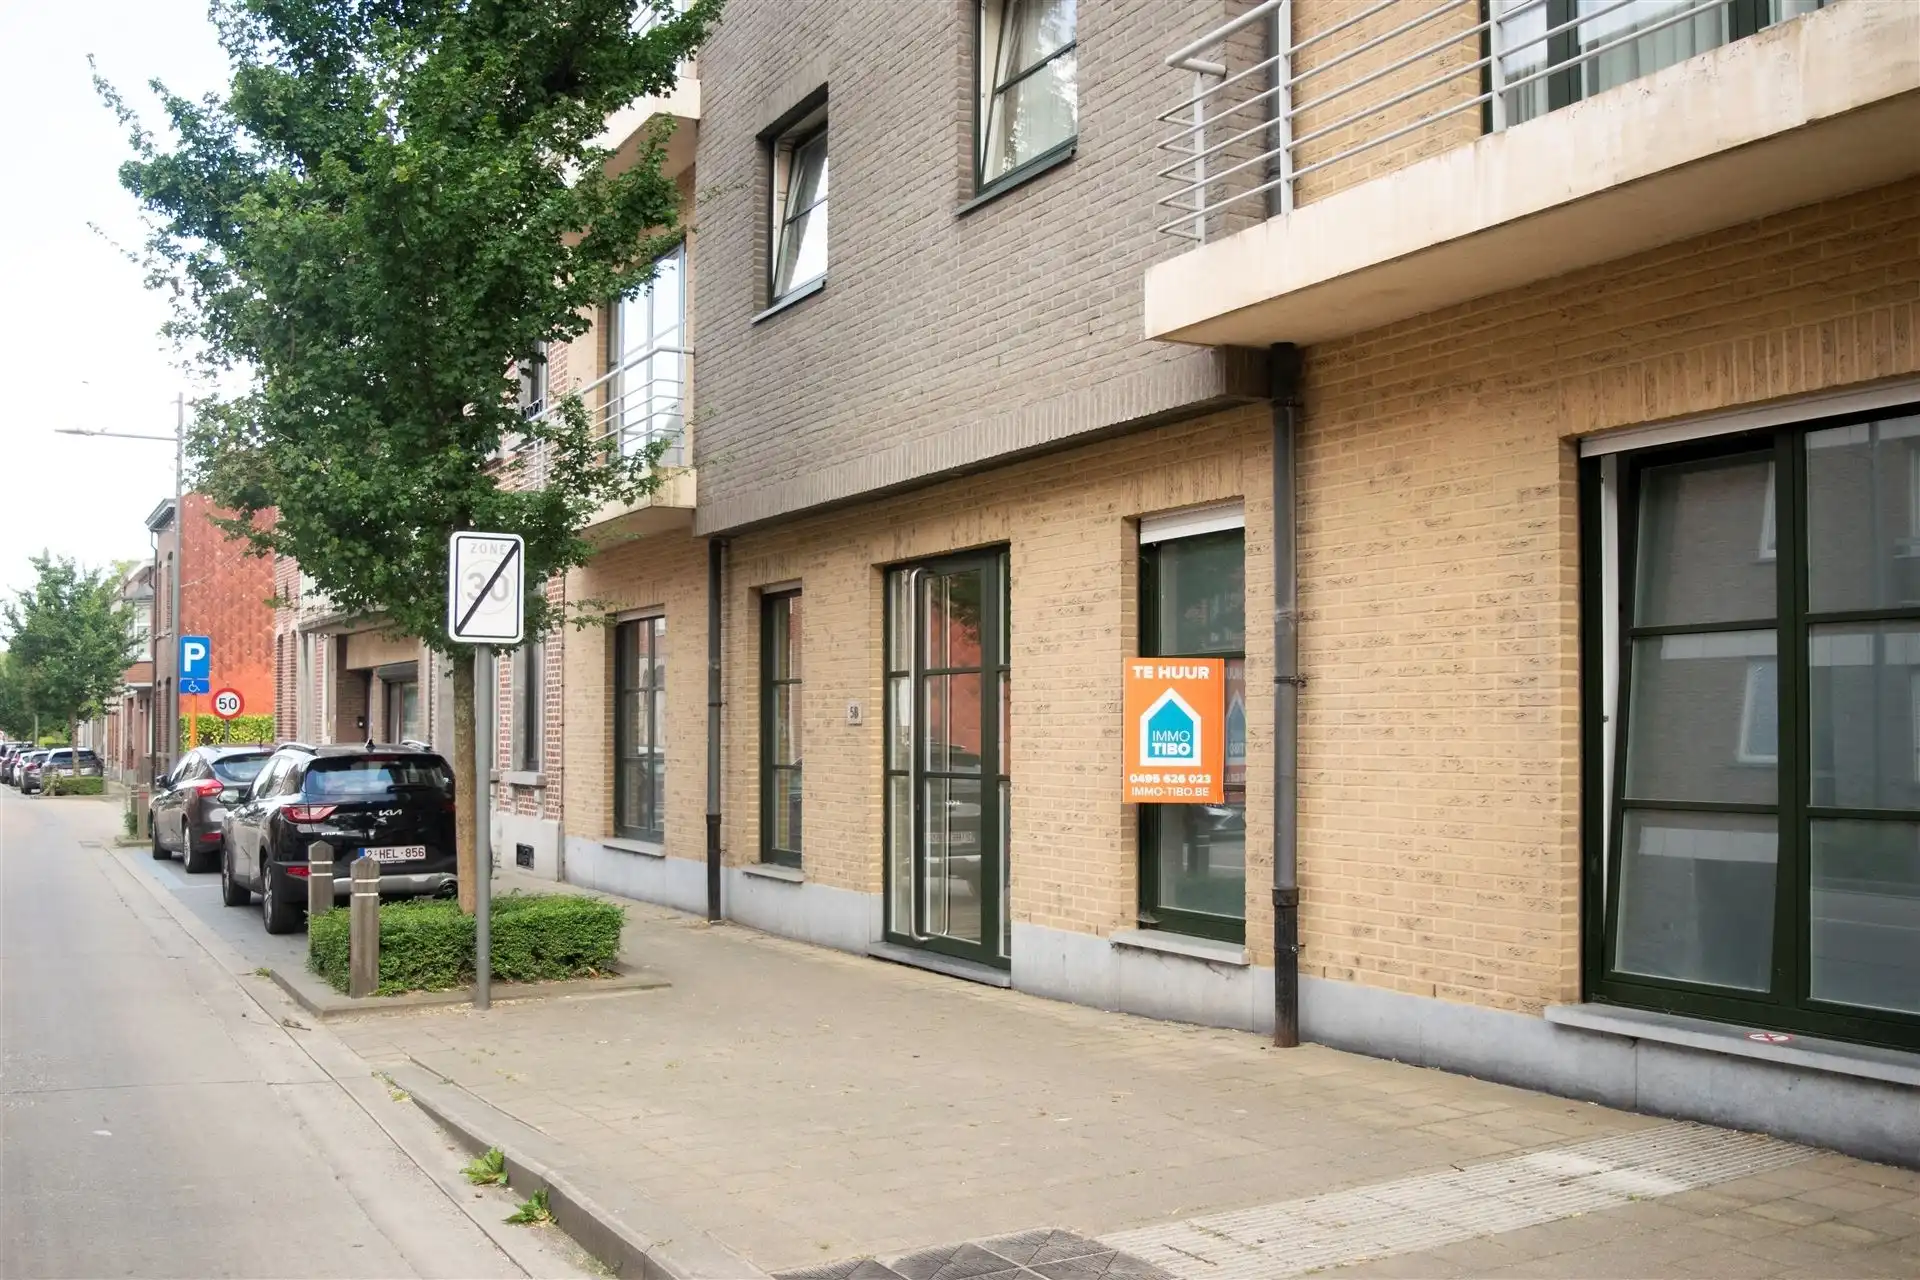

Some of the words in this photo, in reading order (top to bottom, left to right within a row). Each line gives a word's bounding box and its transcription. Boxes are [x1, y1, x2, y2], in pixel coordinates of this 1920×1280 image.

[470, 543, 507, 555] ZONE
[467, 572, 510, 602] 30
[184, 642, 206, 672] P
[1132, 665, 1153, 679] TE
[1158, 665, 1209, 680] HUUR
[218, 697, 238, 710] 50
[1152, 730, 1190, 742] IMMO
[1152, 743, 1190, 756] TIBO
[1131, 787, 1210, 796] IMMO-TIBO.BE
